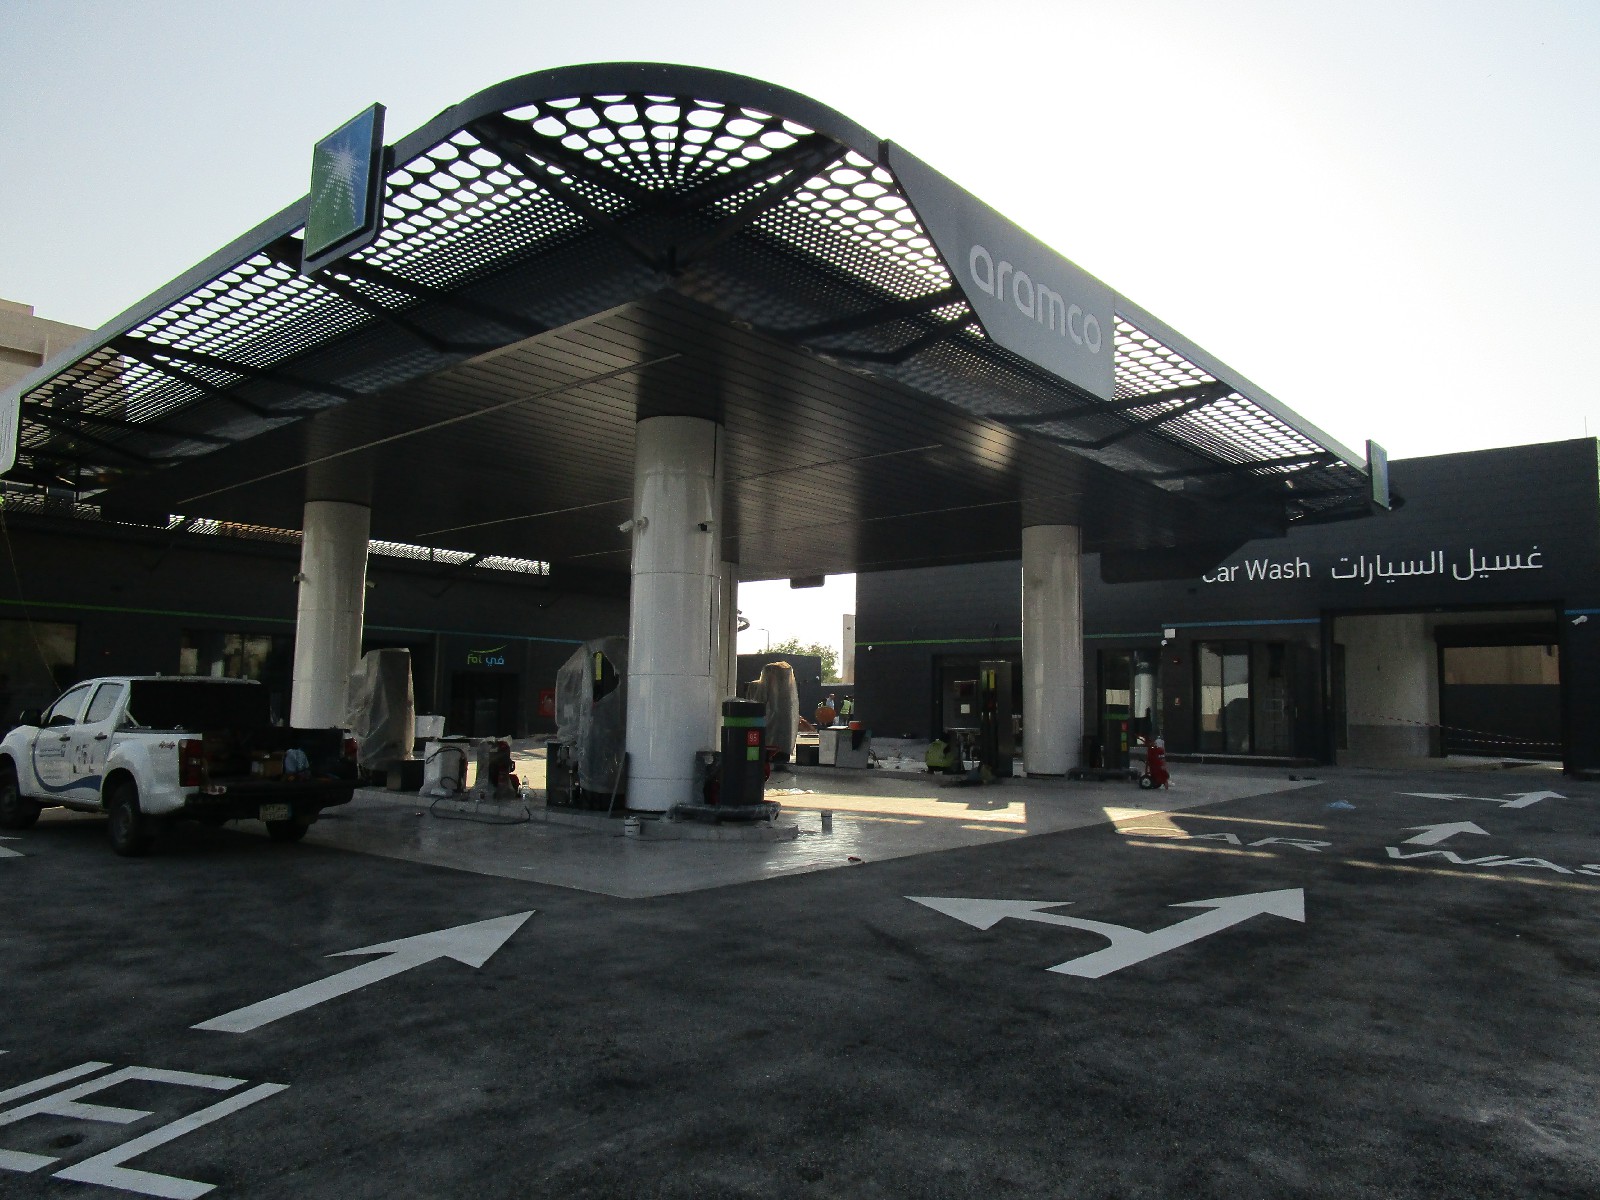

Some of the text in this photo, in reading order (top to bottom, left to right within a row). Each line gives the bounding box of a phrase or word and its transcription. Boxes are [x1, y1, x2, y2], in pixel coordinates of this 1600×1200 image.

[969, 244, 1102, 354] aramco
[1244, 556, 1311, 581] Wash
[1331, 545, 1544, 585] غسيل السيارات
